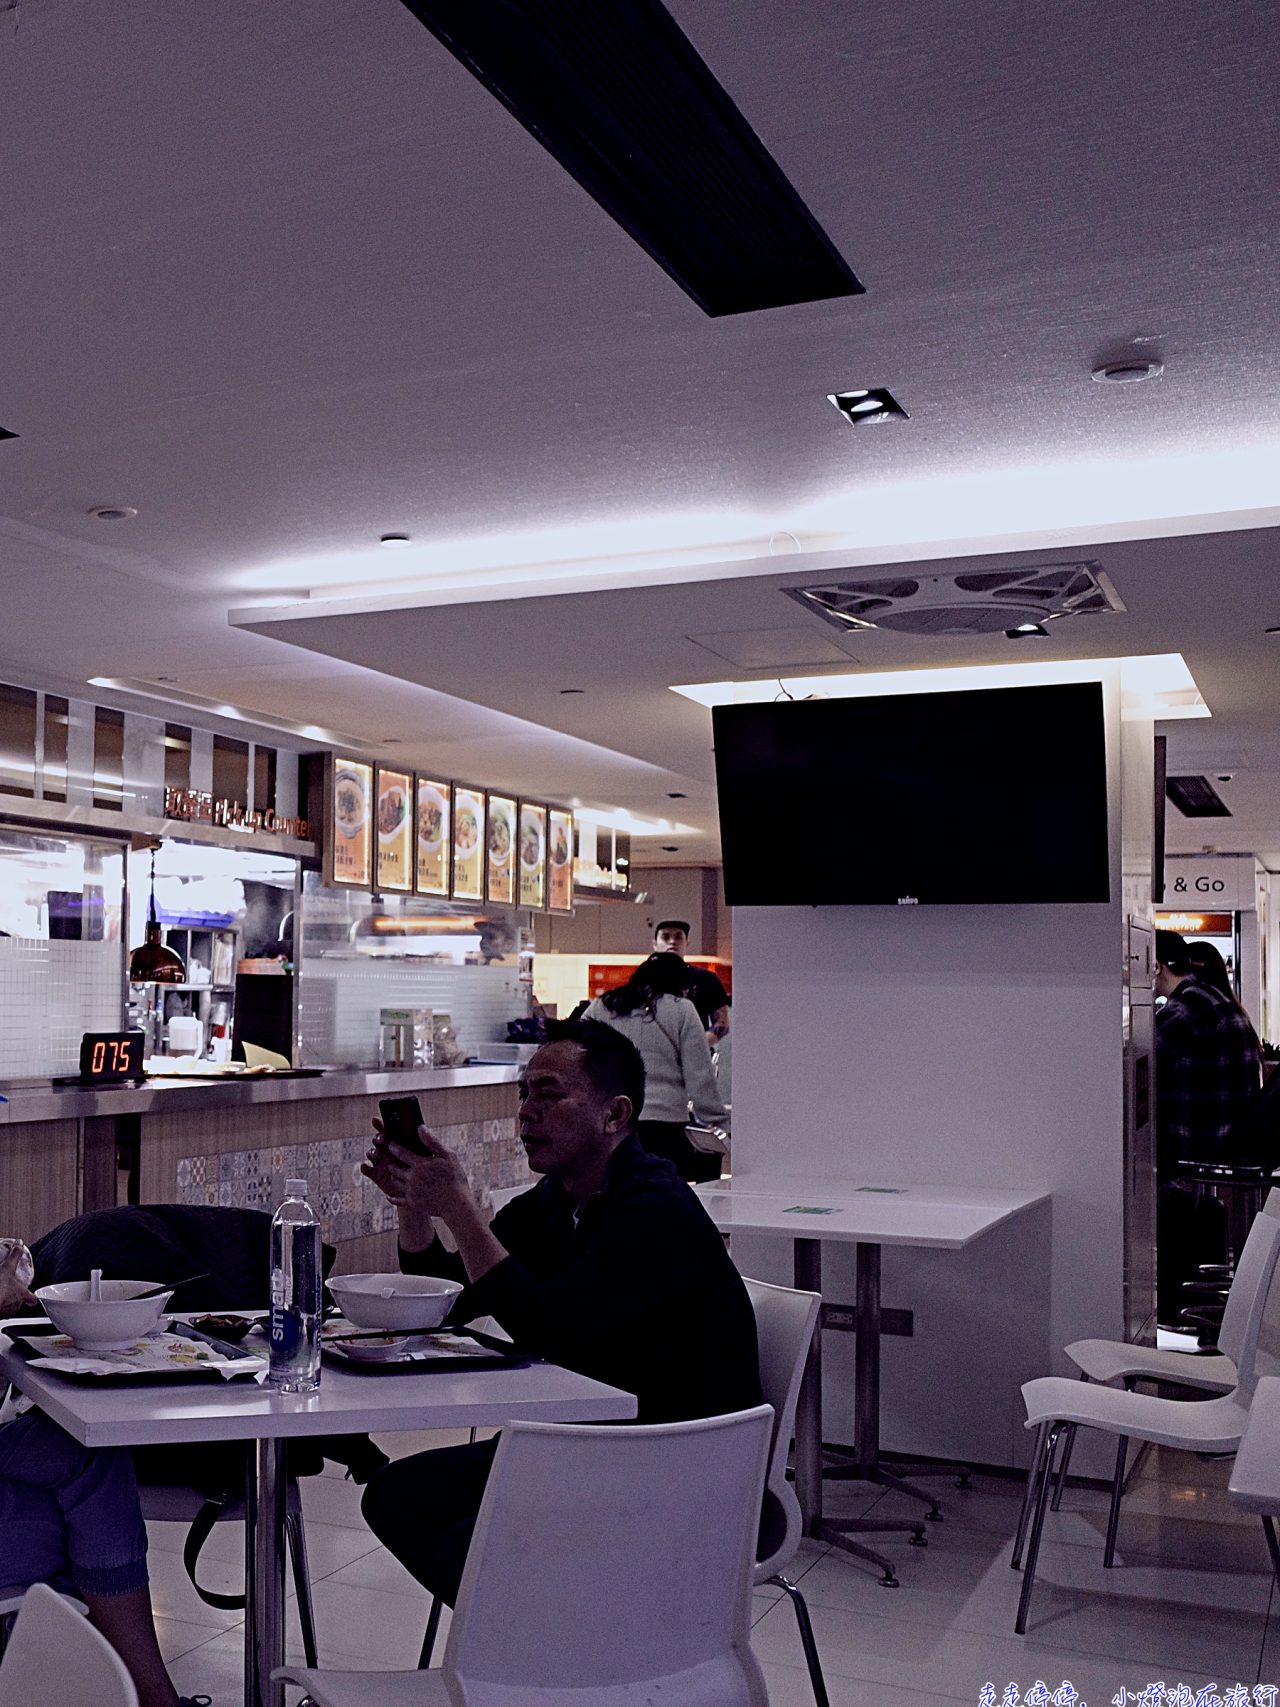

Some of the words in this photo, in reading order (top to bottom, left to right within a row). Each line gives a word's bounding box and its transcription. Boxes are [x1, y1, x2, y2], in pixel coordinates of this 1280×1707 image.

[1173, 877, 1188, 892] &
[1195, 876, 1225, 892] Go
[92, 1041, 131, 1073] 075
[271, 1268, 284, 1342] smart
